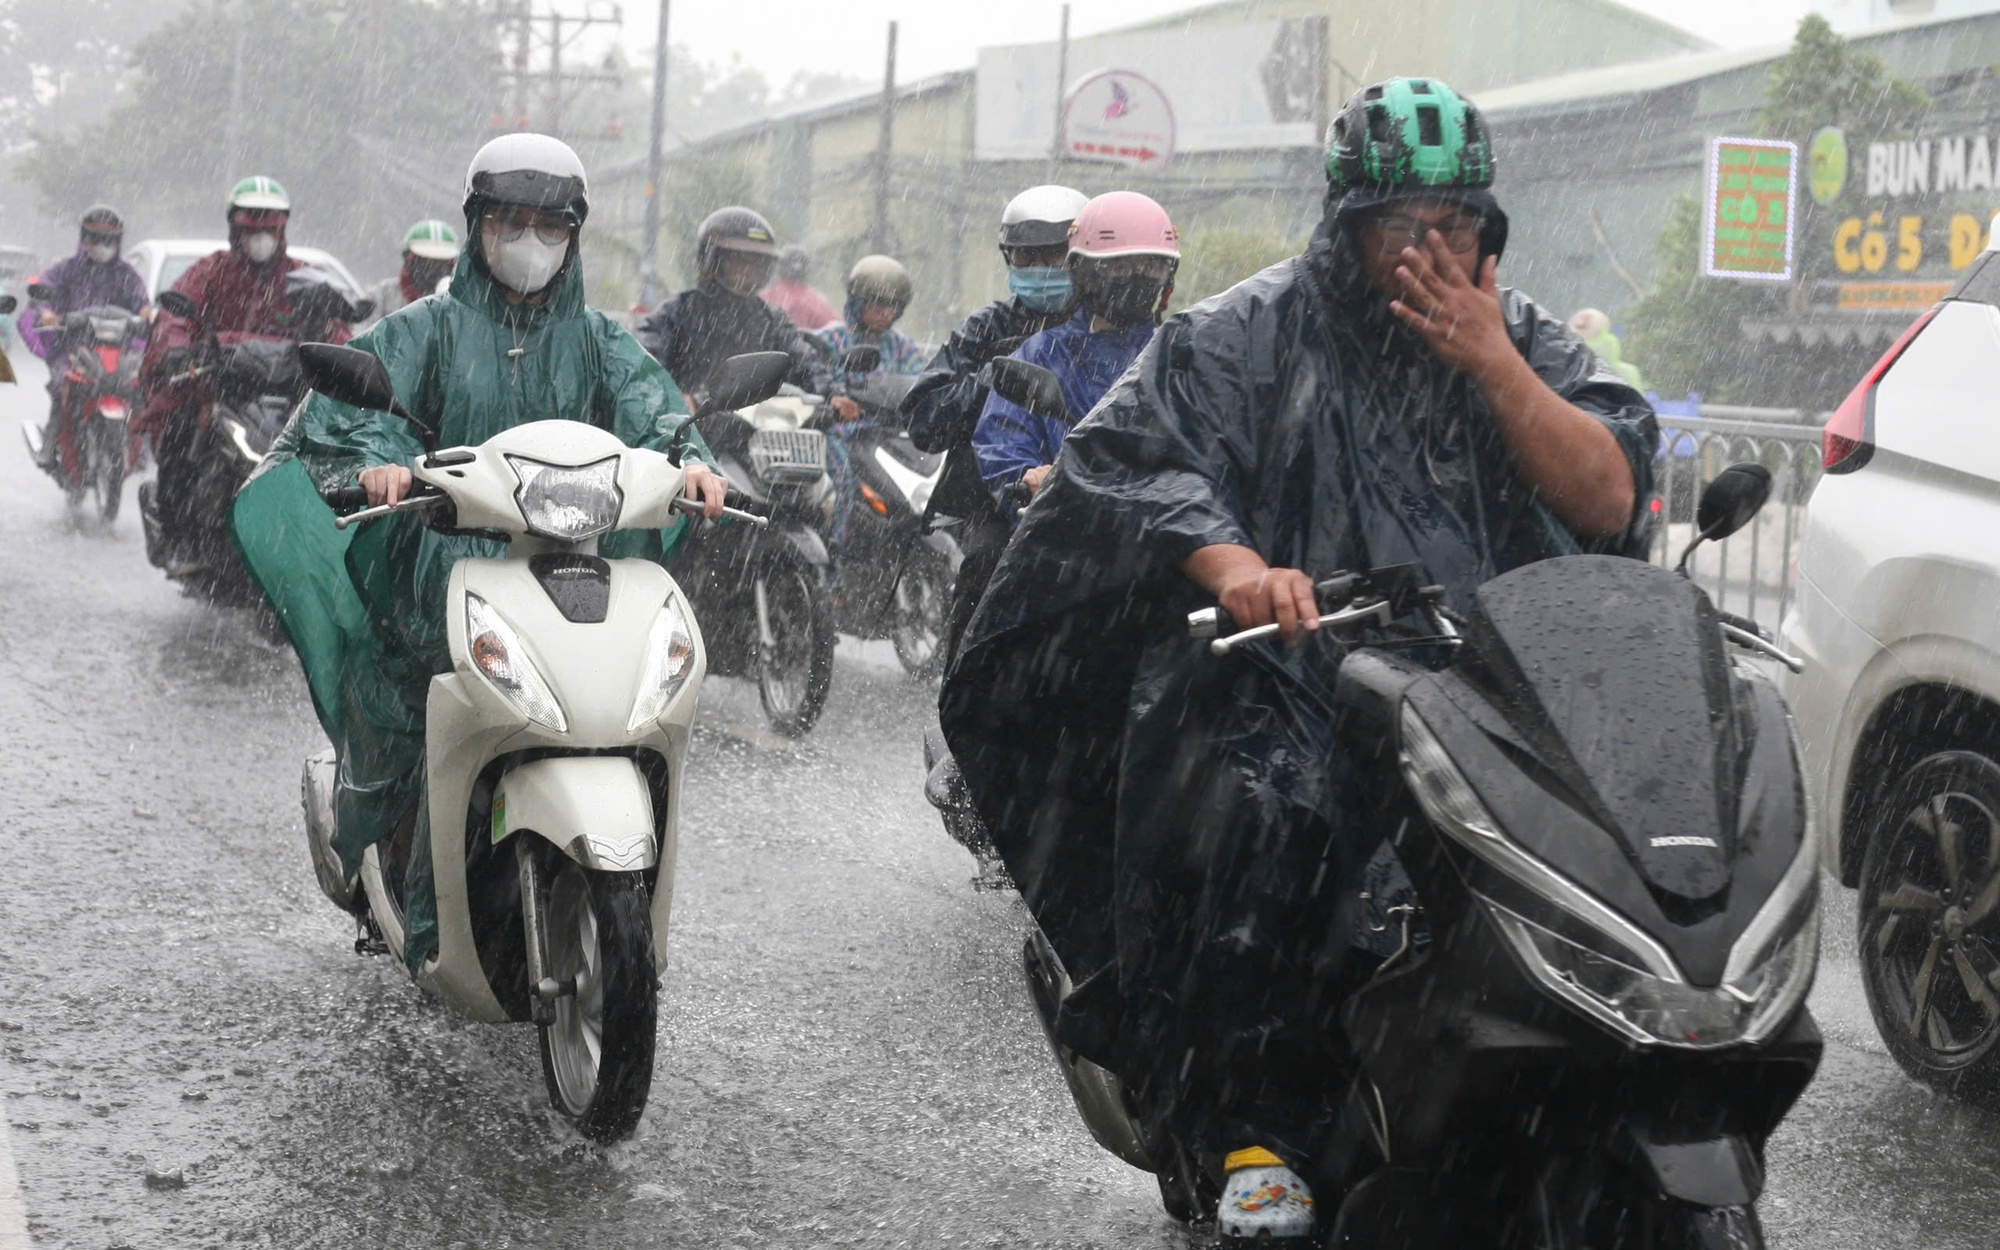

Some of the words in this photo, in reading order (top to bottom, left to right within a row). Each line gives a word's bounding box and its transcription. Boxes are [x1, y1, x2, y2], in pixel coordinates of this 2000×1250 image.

[1720, 193, 1758, 224] CÔ
[1768, 200, 1786, 225] 5
[1834, 210, 1888, 274] Cô
[1896, 215, 1925, 273] 5
[553, 567, 599, 575] HONDA
[1649, 836, 1719, 848] HONDA
